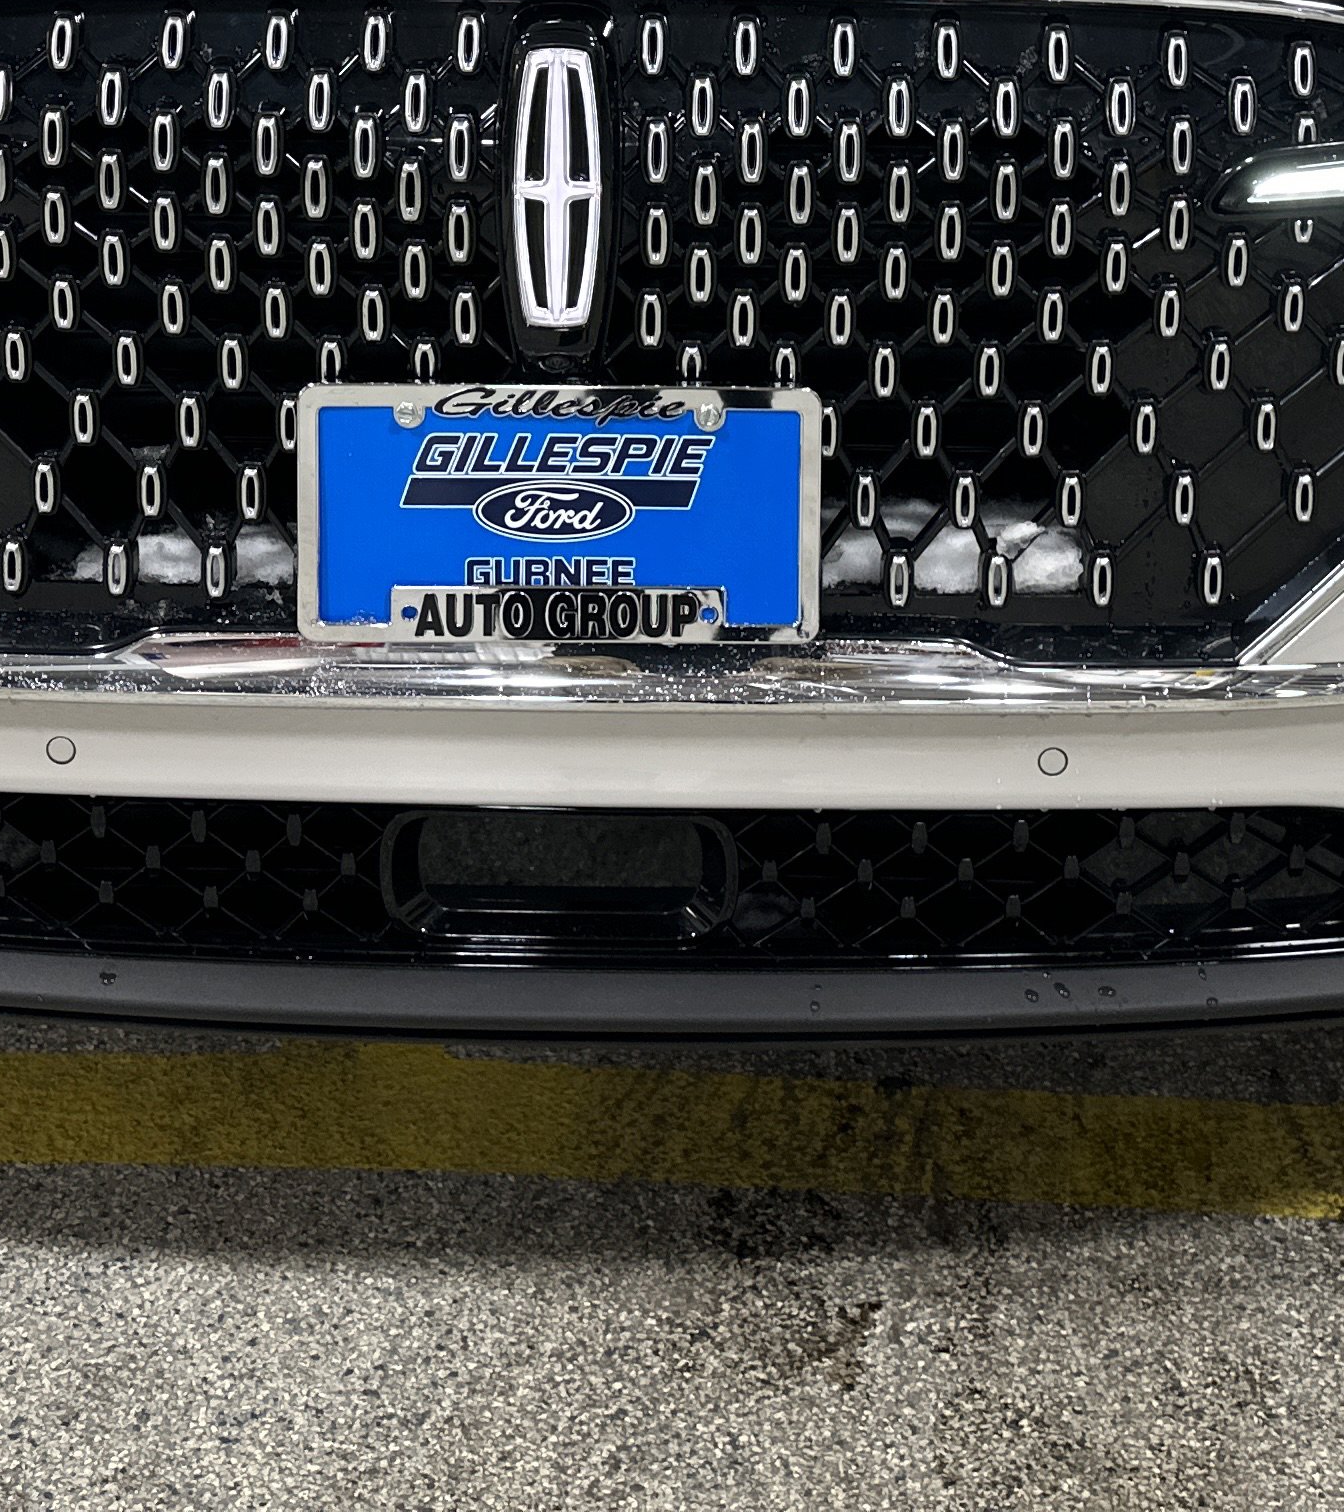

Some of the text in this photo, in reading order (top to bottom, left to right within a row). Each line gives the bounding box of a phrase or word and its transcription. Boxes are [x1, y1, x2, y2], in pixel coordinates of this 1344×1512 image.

[433, 387, 688, 427] Gillespie
[412, 432, 716, 477] GILLESPIE
[503, 491, 602, 531] Ford
[464, 556, 636, 586] GURNEE
[414, 592, 700, 638] AUTO GROUP
